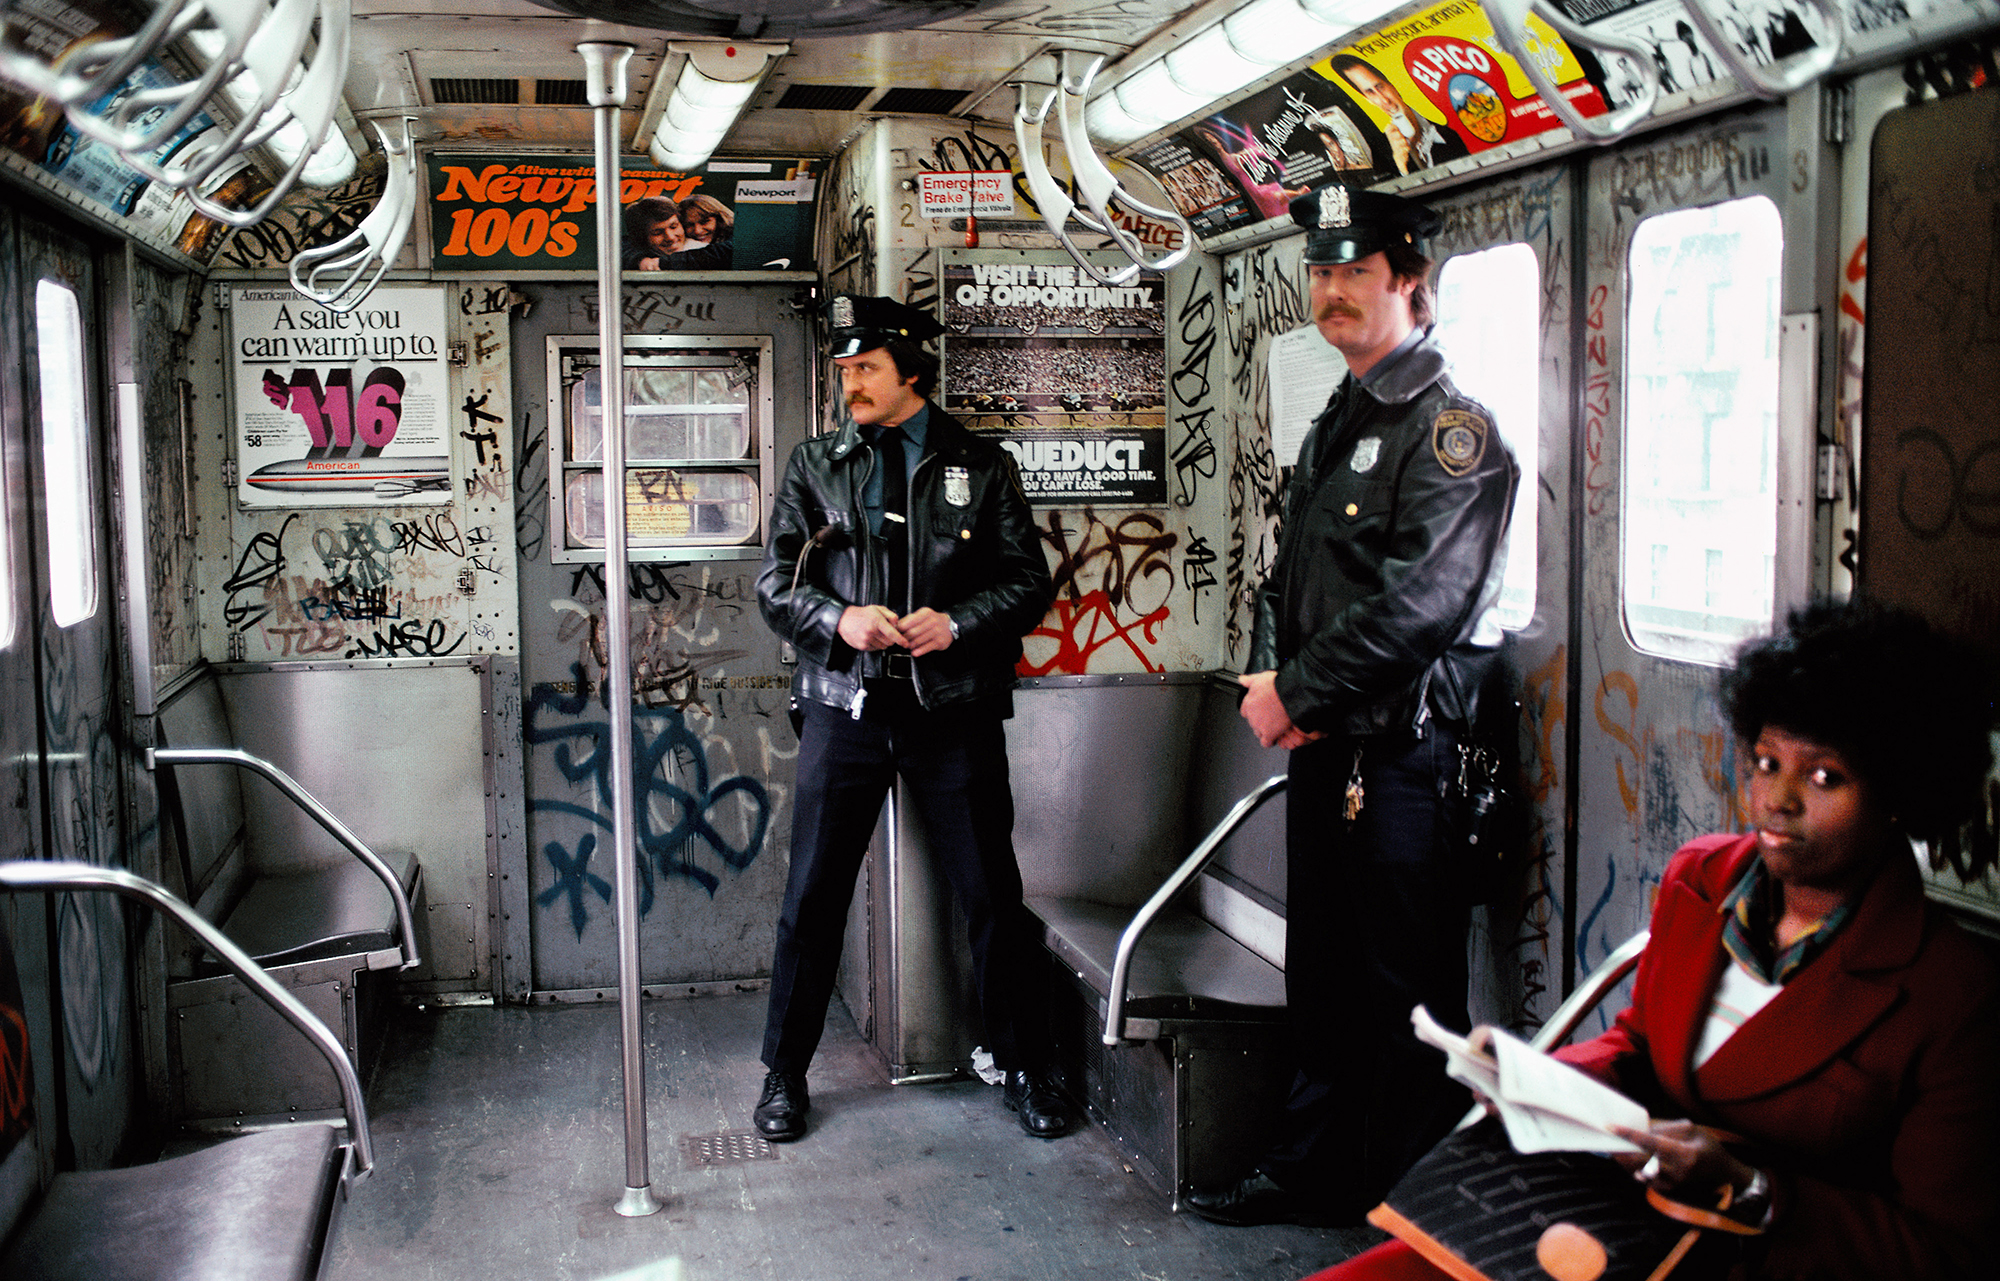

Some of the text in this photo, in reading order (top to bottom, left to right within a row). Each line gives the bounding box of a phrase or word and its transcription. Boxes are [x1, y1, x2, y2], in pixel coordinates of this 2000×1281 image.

[1421, 44, 1491, 73] PICO
[1412, 60, 1443, 92] EL
[508, 165, 558, 176] Alive
[619, 168, 687, 179] leasure!
[436, 165, 704, 213] Newport
[738, 188, 796, 198] Newport
[923, 177, 1001, 191] Emergency
[924, 190, 1005, 203] Brake Valve
[442, 208, 580, 257] 100's
[973, 265, 1035, 286] VISIT
[1036, 265, 1075, 286] THE
[239, 289, 290, 301] American
[956, 285, 1153, 308] OF OPPORTUNITY.
[273, 303, 400, 336] A sale you
[241, 333, 438, 361] can warm up to.
[262, 367, 406, 449] $116
[244, 434, 262, 447] $58
[306, 461, 360, 470] American
[999, 440, 1145, 472] QUEDUCT
[1020, 470, 1157, 482] UT TO HAVE A GOOD TIME,
[1022, 481, 1104, 491] OU CAN'T LOSE.
